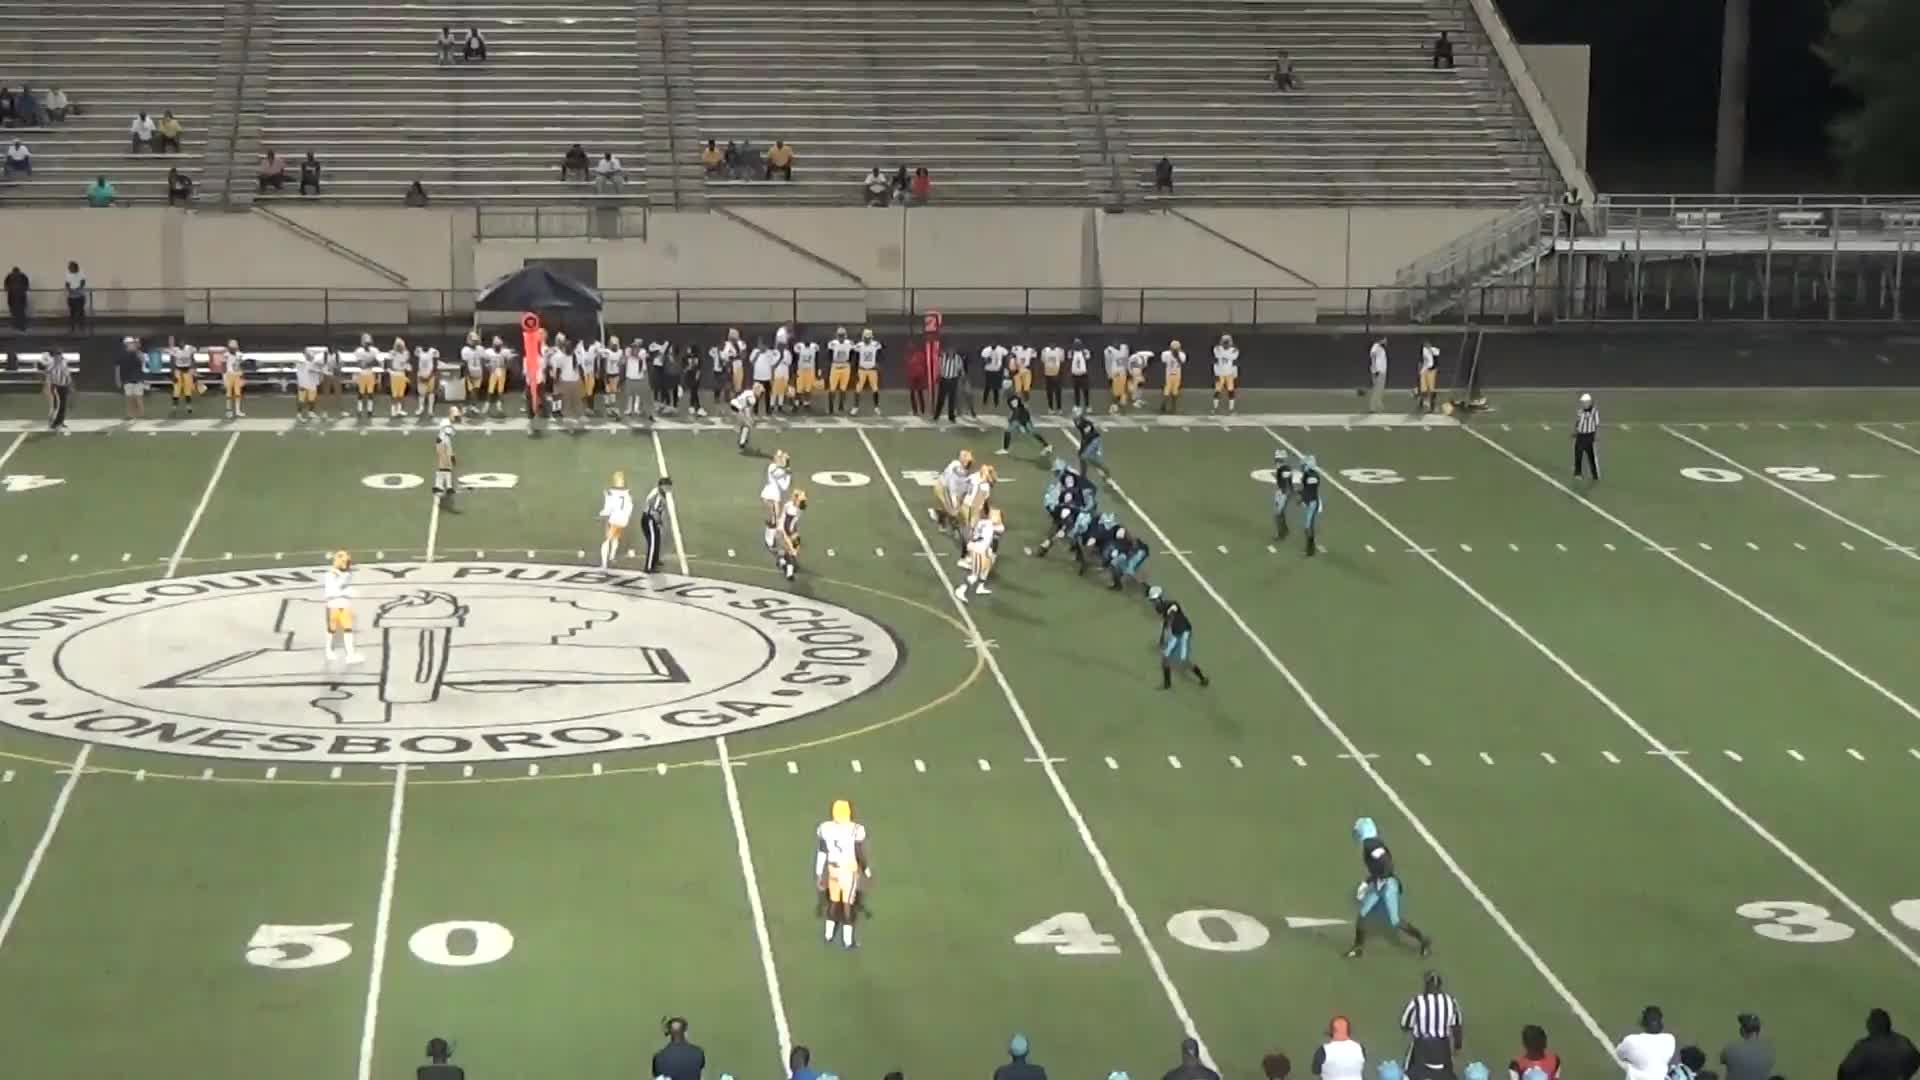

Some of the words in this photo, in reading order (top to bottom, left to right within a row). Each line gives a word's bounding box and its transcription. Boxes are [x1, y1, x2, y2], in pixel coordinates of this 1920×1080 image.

[452, 567, 737, 598] PUBLIC
[728, 598, 872, 686] SCHOOLS
[28, 708, 652, 756] JONESBORO,
